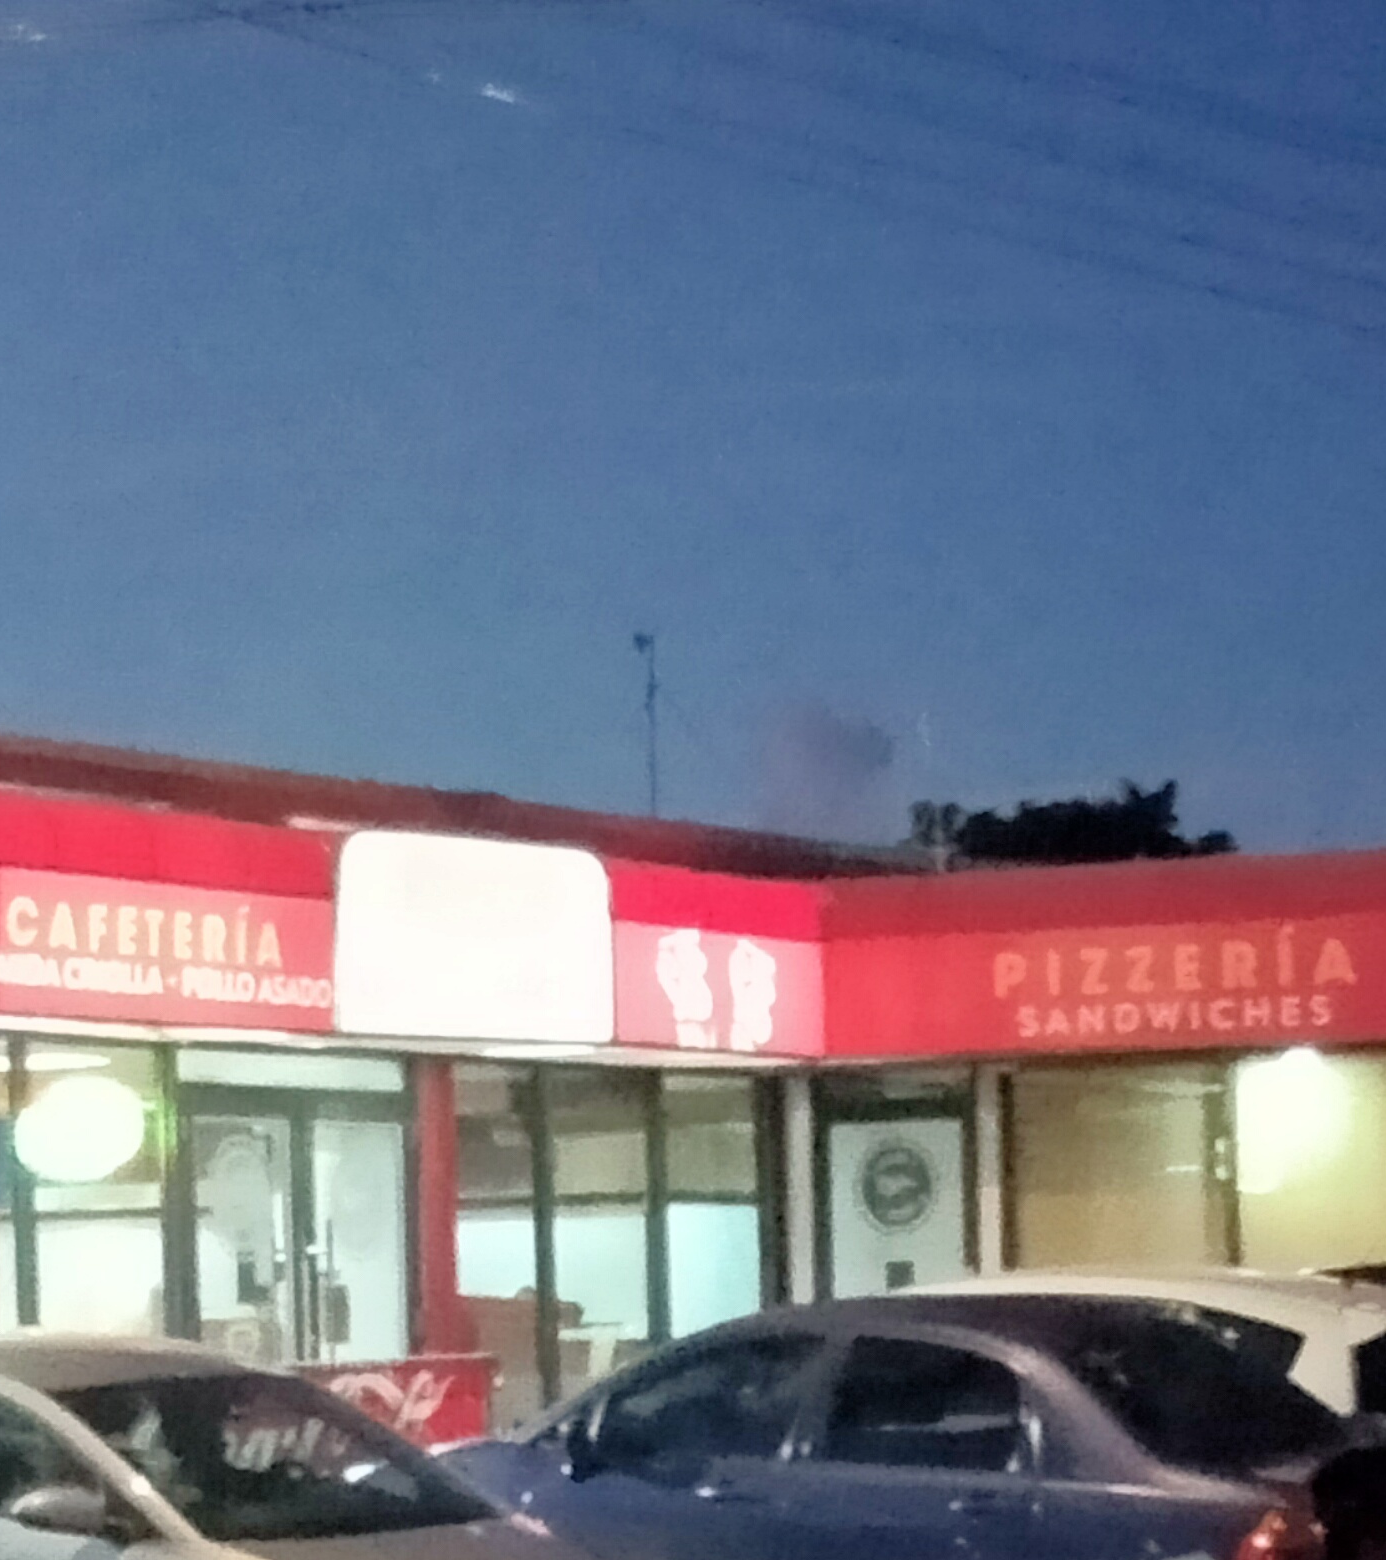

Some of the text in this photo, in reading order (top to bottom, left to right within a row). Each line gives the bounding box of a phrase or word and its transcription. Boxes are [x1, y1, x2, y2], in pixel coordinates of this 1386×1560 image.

[6, 896, 282, 969] CAFETERÍA
[993, 924, 1358, 998] PIZZERÍA
[63, 957, 163, 994] CLLA
[257, 976, 333, 1009] ASADO
[1015, 994, 1333, 1038] SANDWICHES
